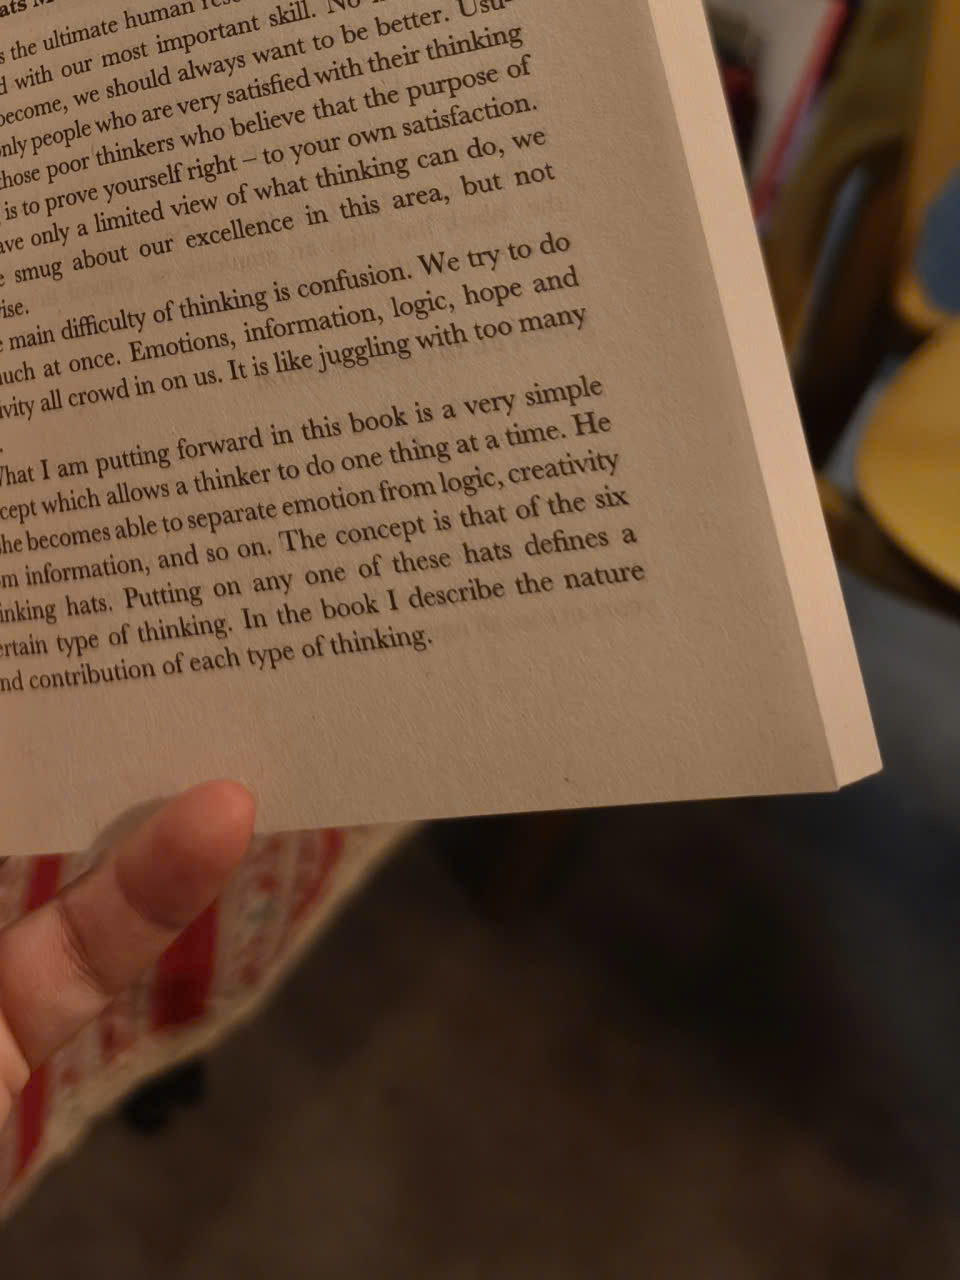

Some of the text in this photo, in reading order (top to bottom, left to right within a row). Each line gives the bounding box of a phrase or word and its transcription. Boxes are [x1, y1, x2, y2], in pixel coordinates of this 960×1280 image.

[10, 40, 37, 61] the
[42, 20, 119, 51] ultimate
[123, 1, 195, 29] human
[30, 222, 69, 247] only
[77, 223, 89, 237] a
[94, 200, 165, 233] limited
[170, 194, 217, 217] view
[226, 182, 248, 206] of
[253, 176, 309, 200] what
[315, 156, 410, 189] thinking
[417, 148, 459, 169] can
[466, 136, 505, 159] do,
[511, 131, 546, 149] we
[43, 359, 61, 378] at
[69, 352, 121, 373] once.
[128, 332, 235, 362] Emotions,
[244, 305, 383, 343] information,
[390, 290, 455, 320] logic,
[462, 282, 523, 307] hope
[532, 264, 579, 294] and
[56, 634, 99, 658] type
[108, 623, 131, 646] of
[138, 614, 233, 644] thinking.
[240, 608, 268, 629] In
[276, 603, 312, 626] the
[320, 592, 380, 620] book
[386, 589, 399, 611] I
[408, 577, 505, 609] describe
[514, 572, 553, 595] the
[563, 565, 645, 589] nature
